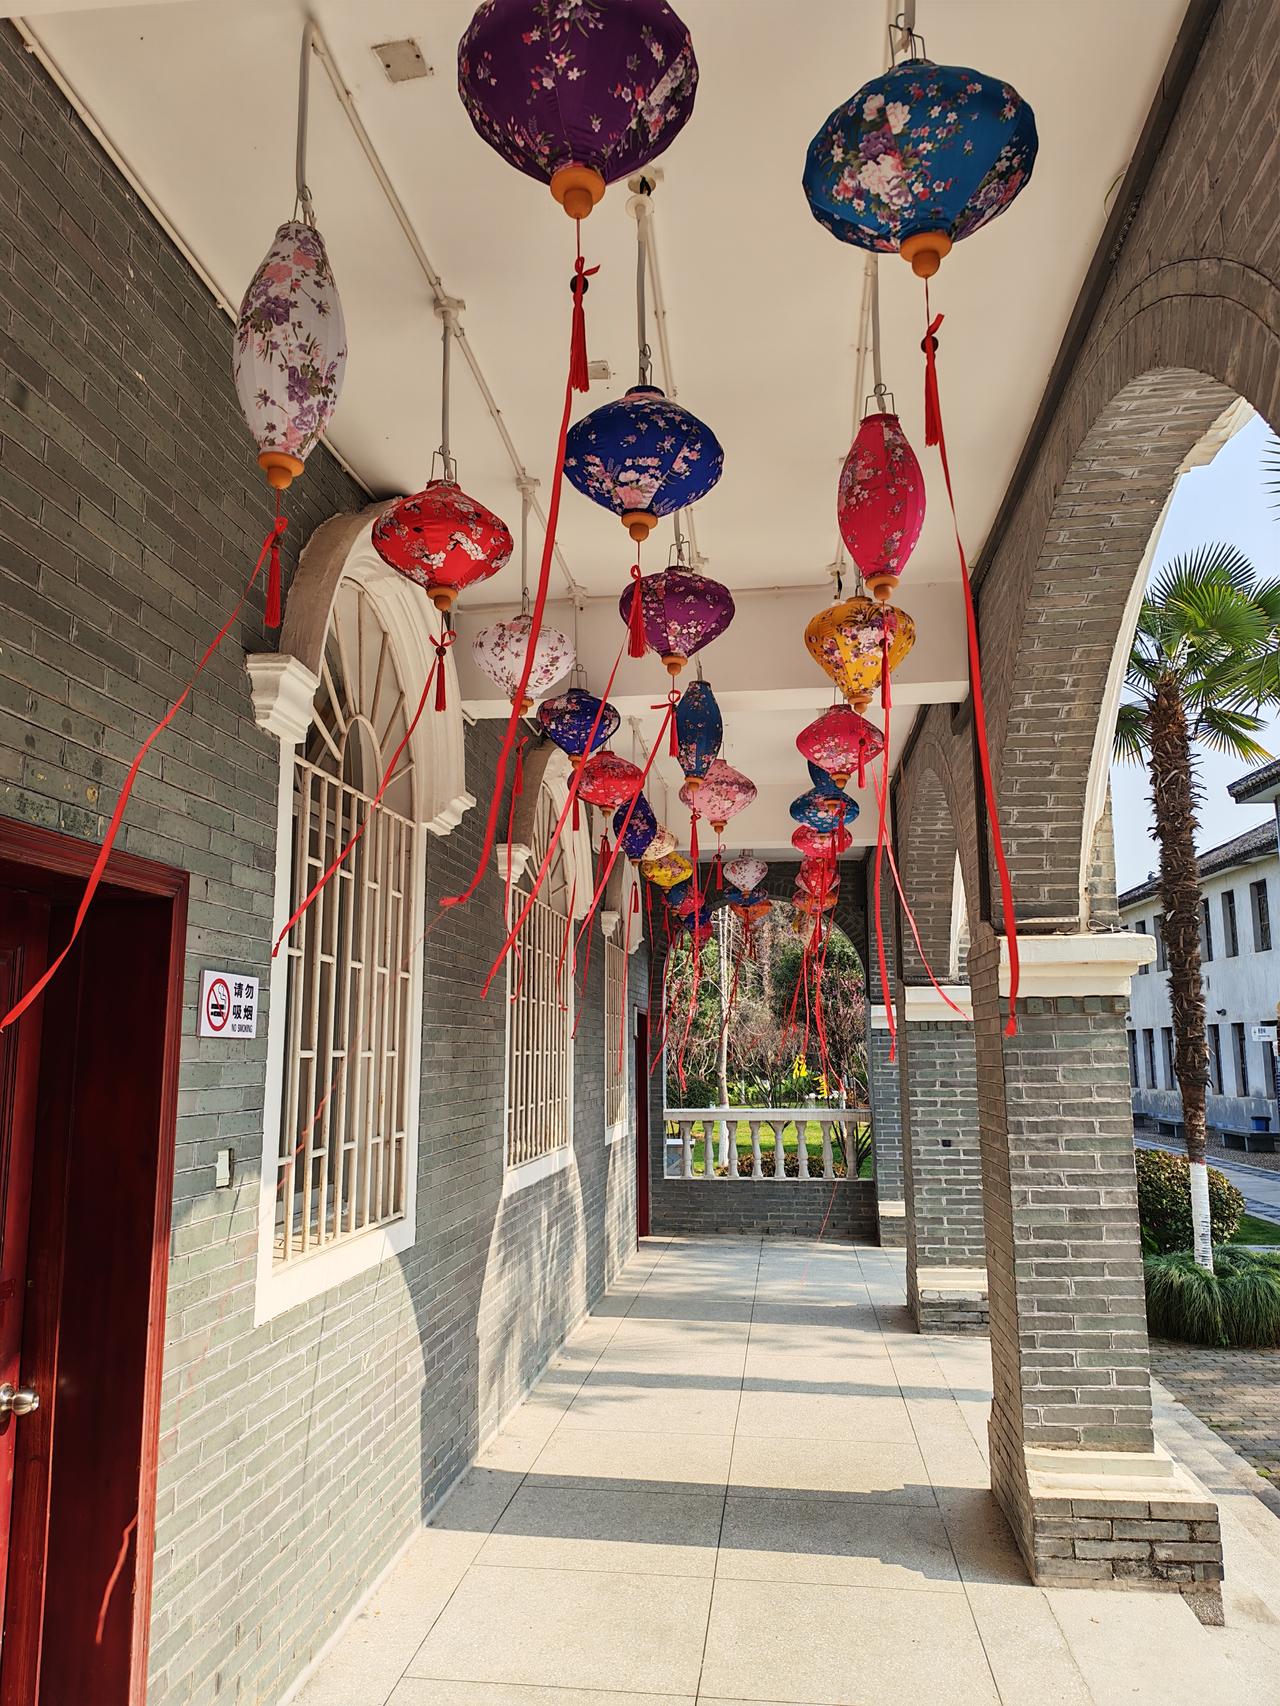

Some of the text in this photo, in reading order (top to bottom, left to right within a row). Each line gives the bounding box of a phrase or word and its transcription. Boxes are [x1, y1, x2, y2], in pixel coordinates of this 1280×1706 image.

[234, 982, 254, 999] 请勿
[233, 1005, 253, 1021] 吸烟
[232, 1024, 253, 1033] NO SMOKING
